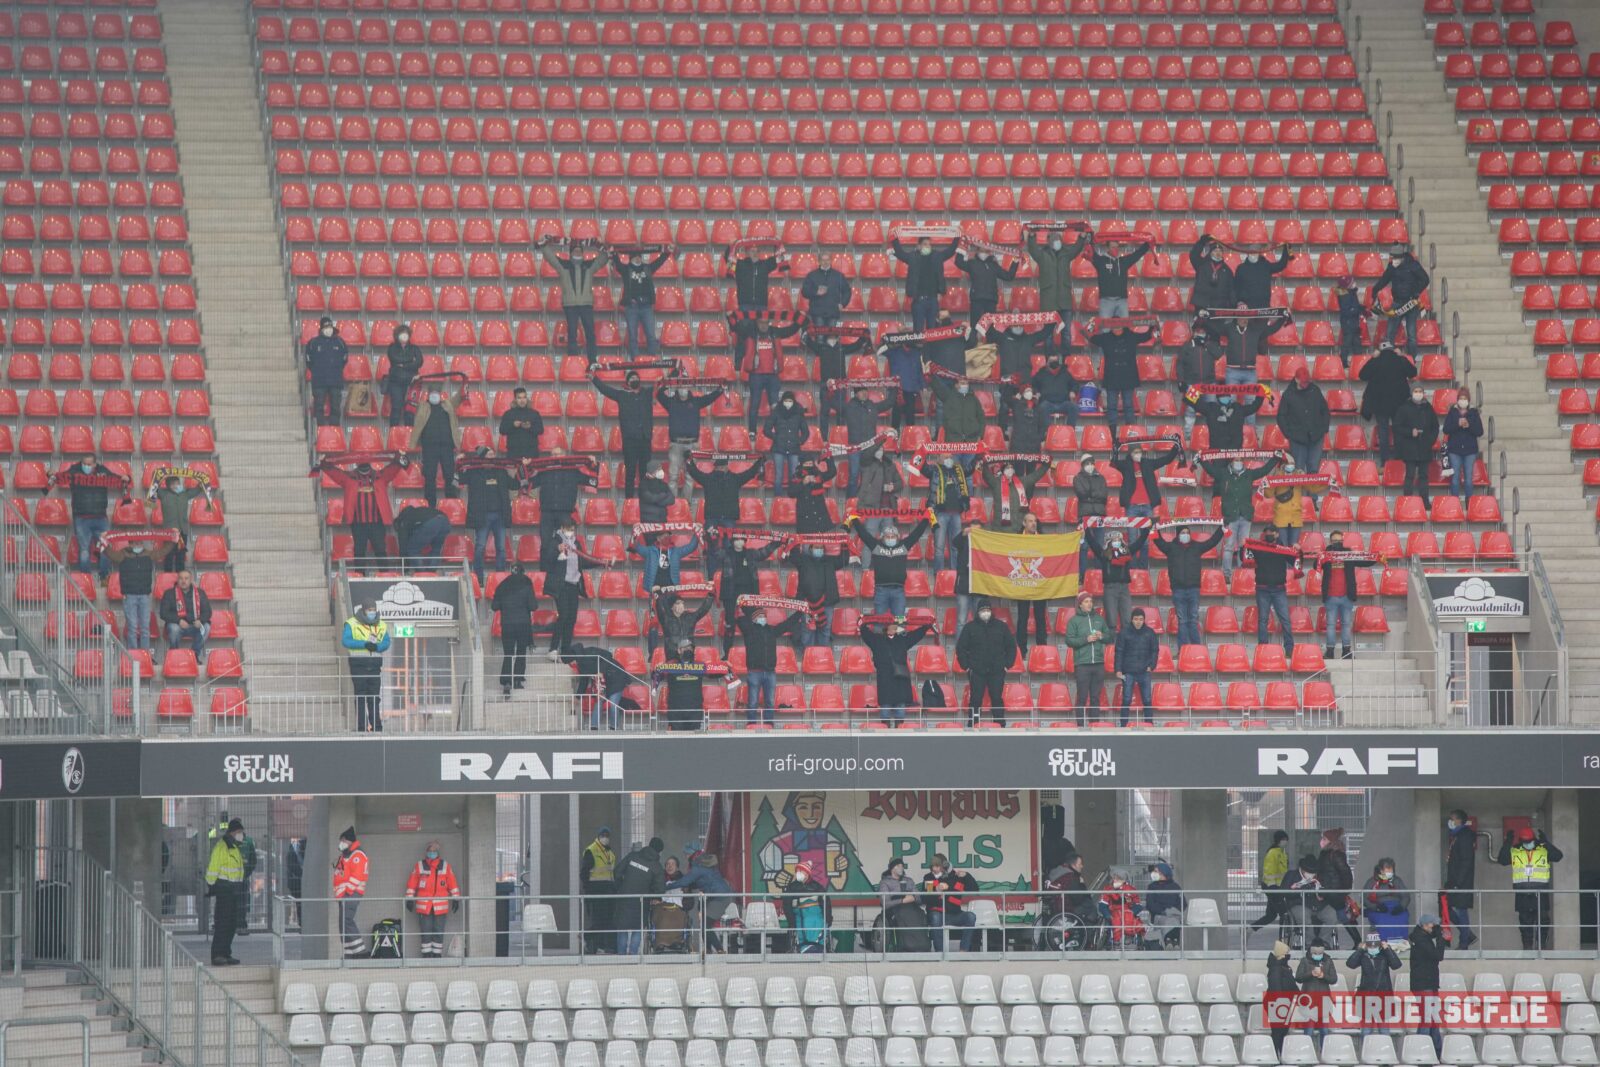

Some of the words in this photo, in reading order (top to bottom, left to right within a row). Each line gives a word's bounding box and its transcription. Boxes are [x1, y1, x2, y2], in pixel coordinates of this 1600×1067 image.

[381, 607, 450, 617] arzwaldmilch
[1435, 602, 1521, 613] chwarzwaldmilch
[684, 663, 704, 671] PARK
[223, 754, 264, 769] GET
[269, 754, 289, 769] IN
[1048, 748, 1087, 764] GET
[1092, 748, 1111, 763] IN
[1257, 747, 1439, 775] RAFI
[440, 752, 624, 781] RAFI
[767, 753, 905, 775] rafi-group.com
[1049, 762, 1116, 777] TOUCH
[224, 768, 294, 783] TOUCH
[887, 834, 1004, 869] PILS
